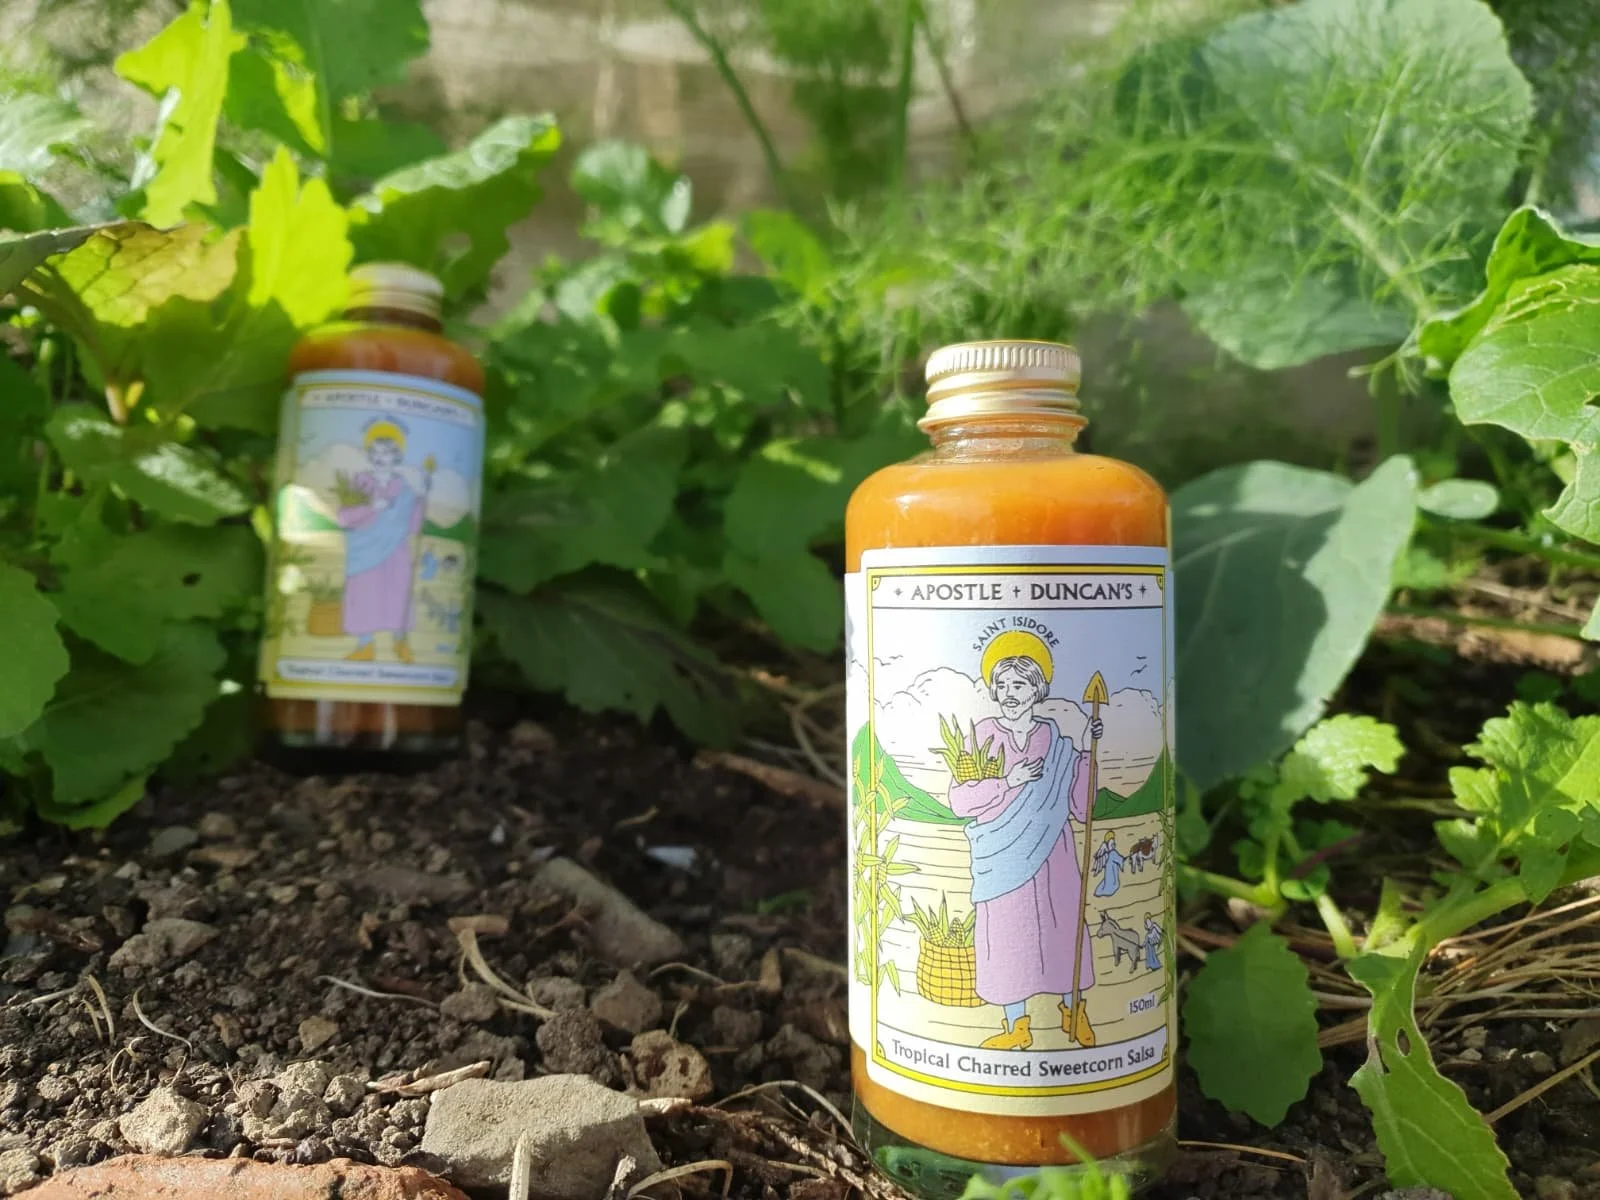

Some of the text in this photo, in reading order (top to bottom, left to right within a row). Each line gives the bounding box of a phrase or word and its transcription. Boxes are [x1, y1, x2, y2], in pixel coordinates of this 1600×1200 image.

[911, 582, 1134, 601] APOSTLE DUNCAN'S
[972, 616, 1060, 652] SAINT ISIDORE
[1128, 995, 1156, 1014] 150ml
[892, 1039, 1155, 1077] Tropical Charred Sweetcorn Salsa
